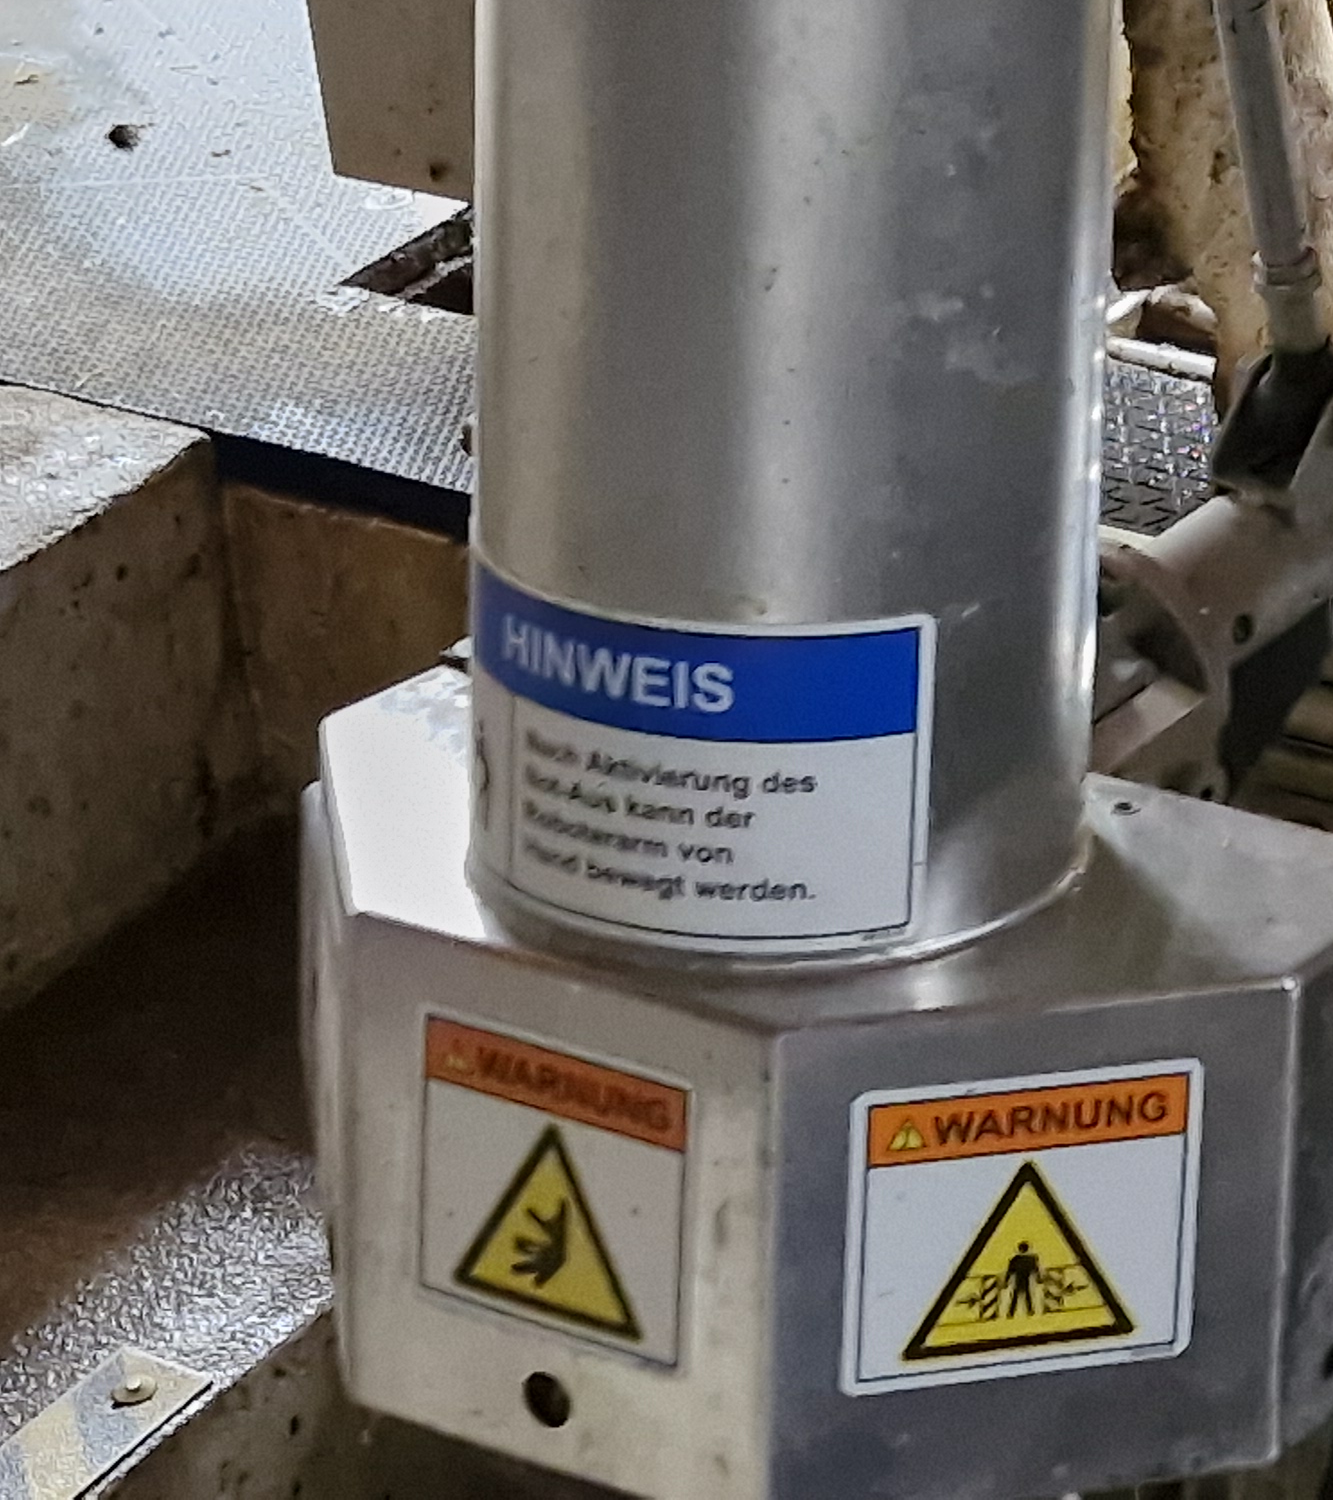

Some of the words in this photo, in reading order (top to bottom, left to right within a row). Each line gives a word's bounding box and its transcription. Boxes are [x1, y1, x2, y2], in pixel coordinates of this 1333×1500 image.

[501, 614, 735, 713] HINWEIS
[761, 769, 819, 794] des
[705, 805, 757, 829] der
[678, 842, 734, 864] von
[695, 877, 818, 902] werden.
[470, 1043, 675, 1137] WARNUNG
[930, 1087, 1170, 1148] WARNUNG
